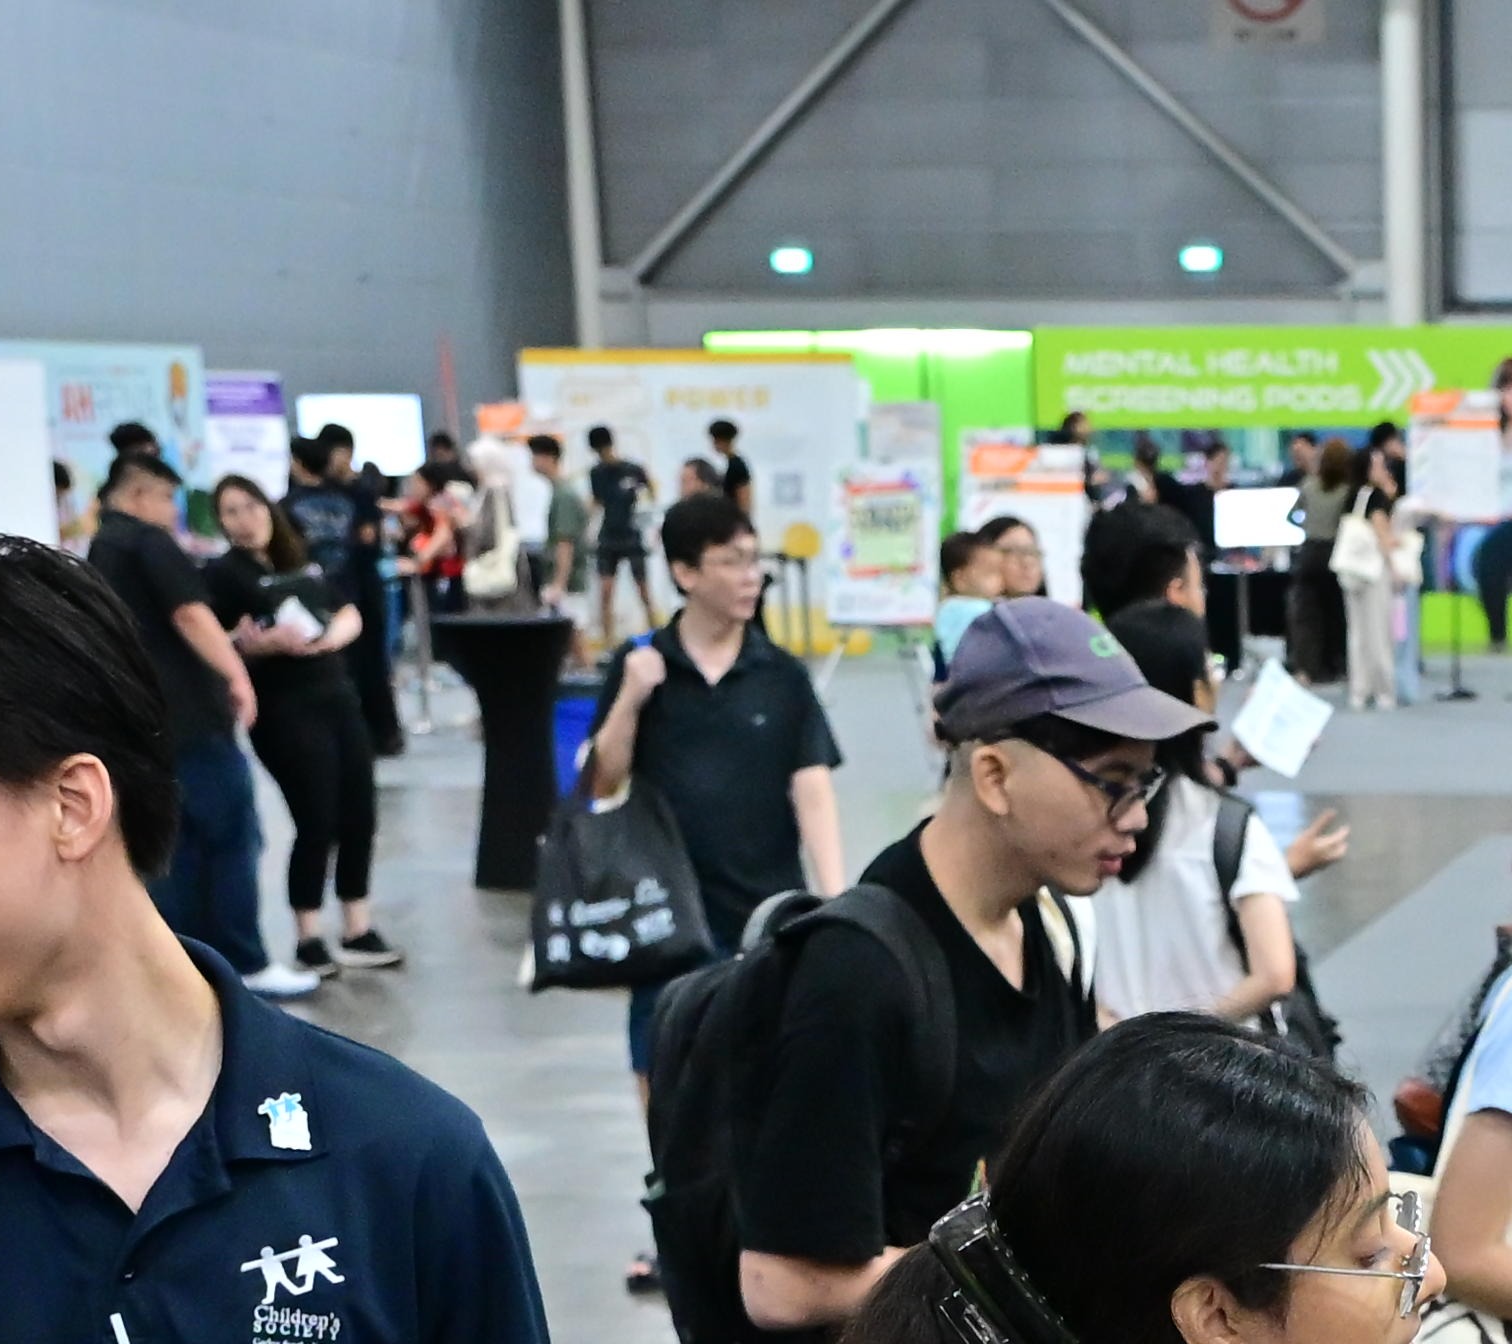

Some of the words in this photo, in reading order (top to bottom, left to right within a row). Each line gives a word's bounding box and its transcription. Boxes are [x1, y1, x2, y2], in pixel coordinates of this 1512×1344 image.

[1064, 350, 1198, 378] MENTAL
[1207, 350, 1339, 377] HEALTH
[1064, 384, 1257, 412] SCREENING
[1263, 384, 1364, 411] PODS
[253, 1305, 341, 1331] Children's
[253, 1319, 341, 1341] SOCIETY
